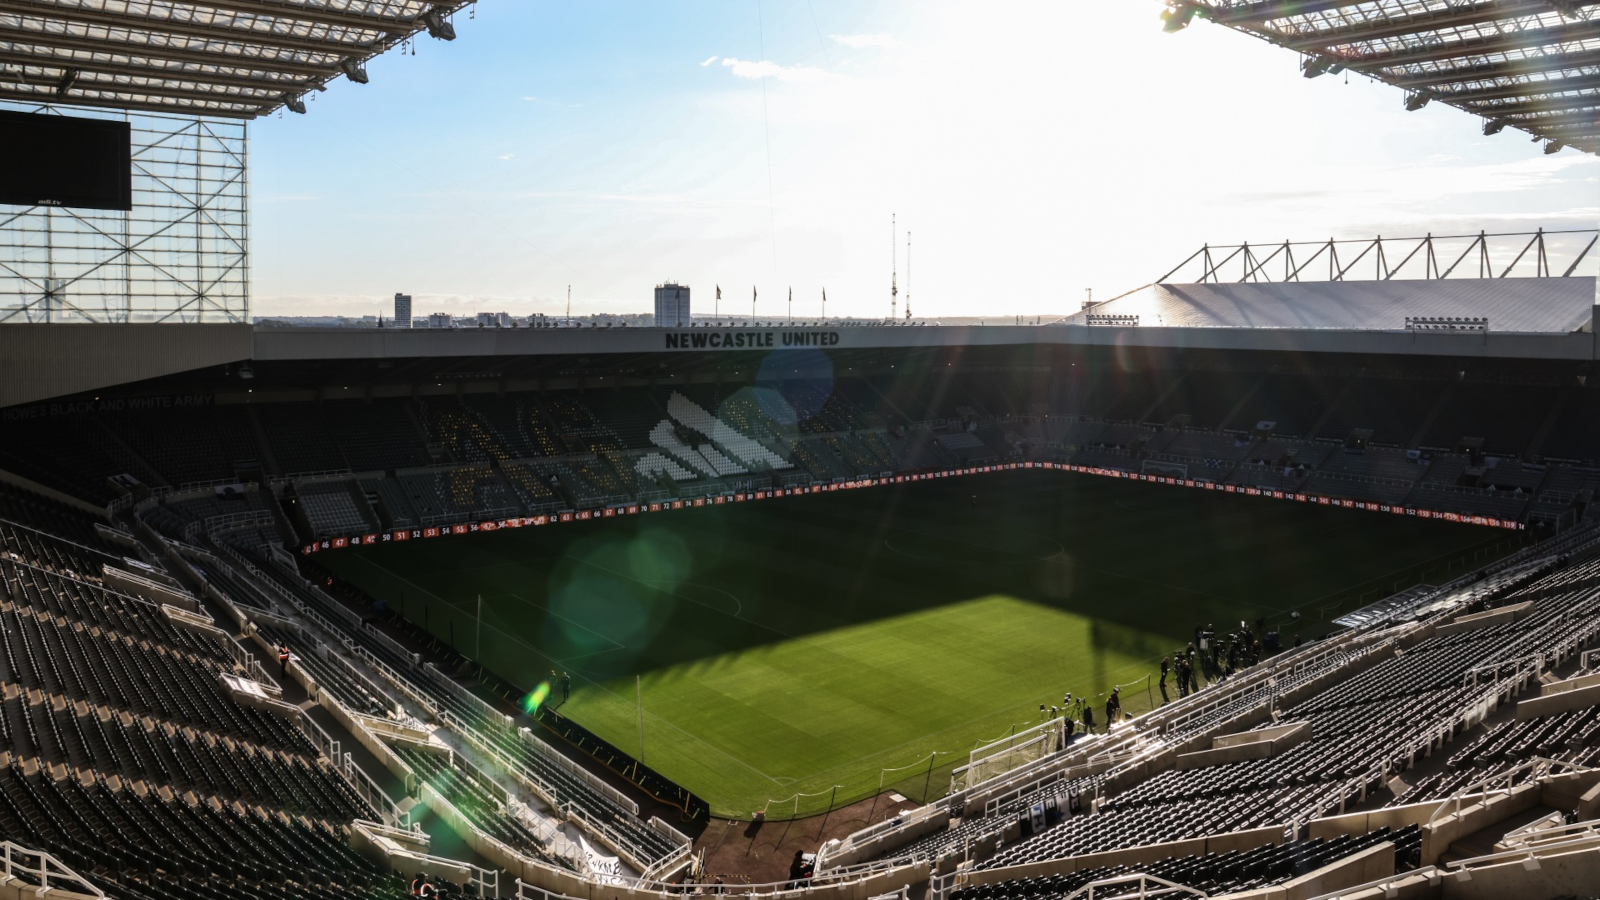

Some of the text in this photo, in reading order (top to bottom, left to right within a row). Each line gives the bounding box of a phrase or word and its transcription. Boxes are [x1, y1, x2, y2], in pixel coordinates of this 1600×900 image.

[666, 332, 839, 348] NEWCASTLE UNITED
[3, 394, 213, 421] HOWE'S BLACK AND WHITE ARMY
[1355, 501, 1365, 509] 148
[1406, 508, 1416, 516] 152
[1432, 511, 1443, 519] 154
[321, 541, 329, 549] 46
[351, 537, 360, 545] 48
[382, 534, 391, 542] 50
[398, 532, 405, 540] 51
[412, 530, 421, 538] 52
[442, 527, 450, 535] 54
[550, 515, 558, 523] 62
[581, 511, 588, 519] 65
[593, 510, 601, 518] 66
